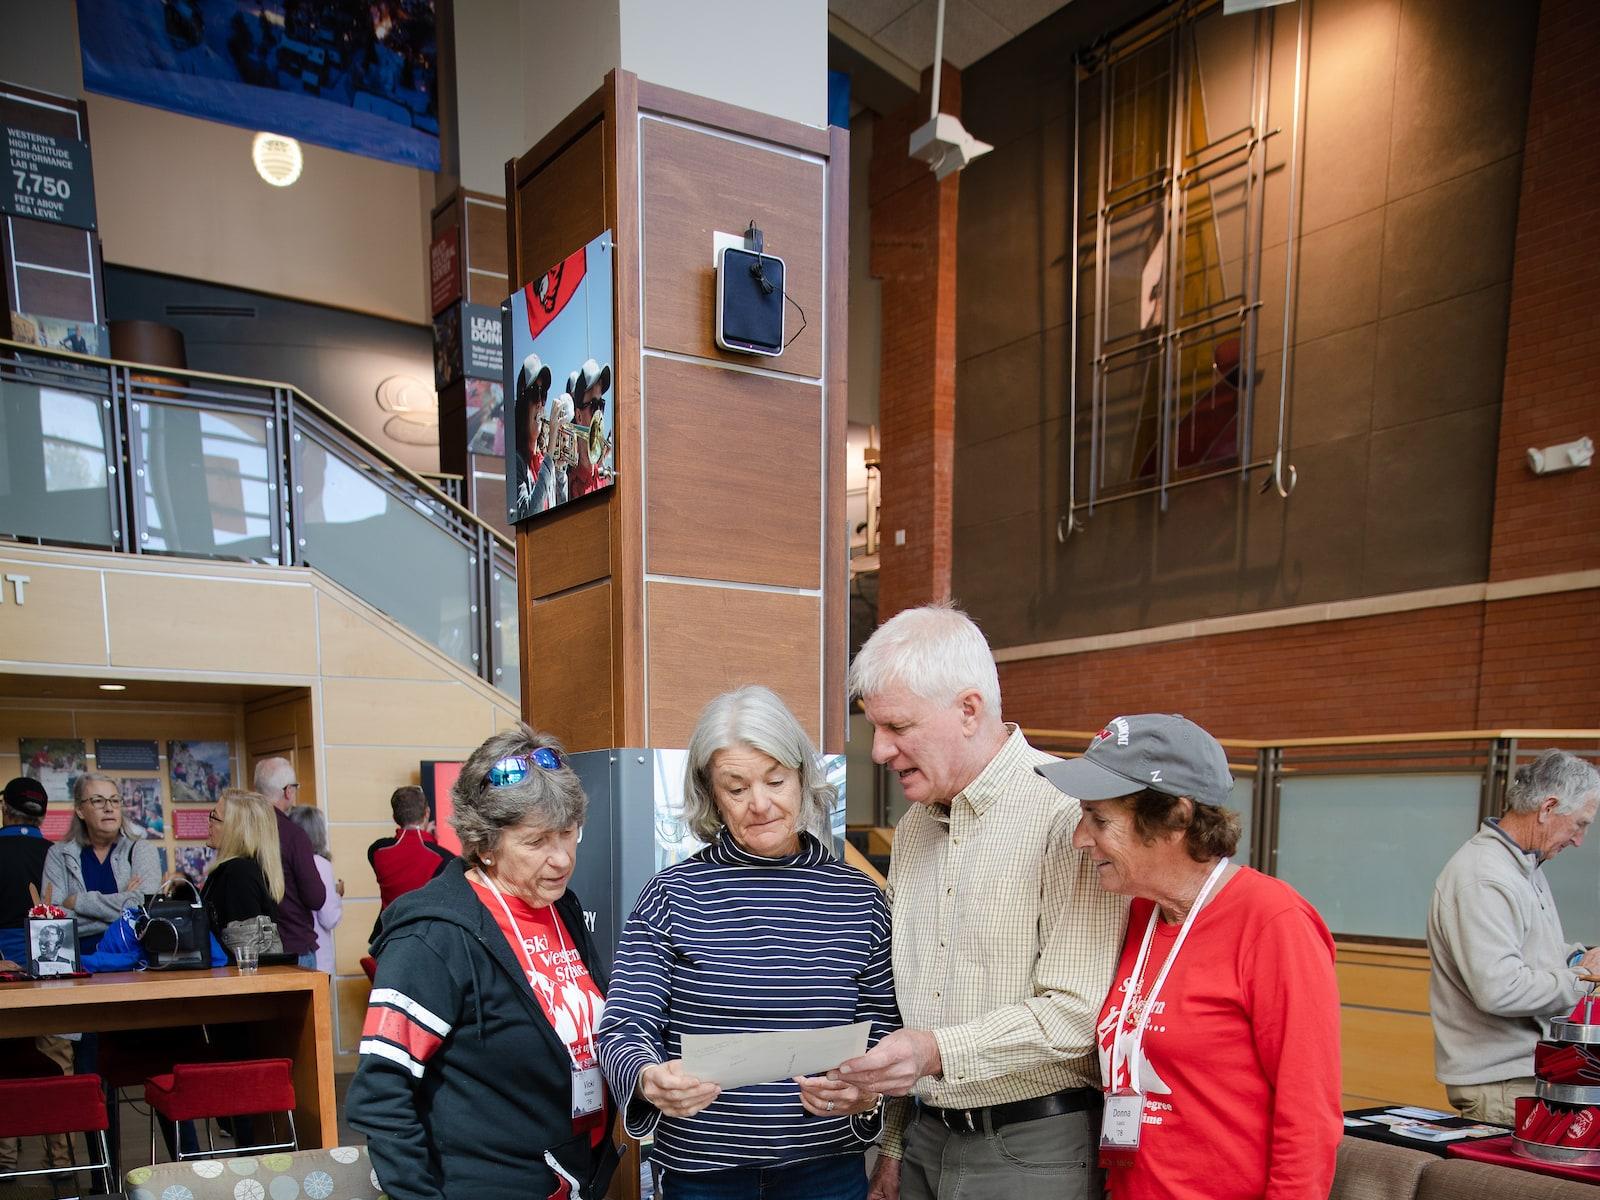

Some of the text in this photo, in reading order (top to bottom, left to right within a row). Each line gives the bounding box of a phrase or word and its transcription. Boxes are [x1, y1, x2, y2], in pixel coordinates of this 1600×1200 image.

[7, 127, 56, 146] WESTERN'S
[9, 138, 69, 159] HIGH ALTITUDE
[10, 148, 73, 170] PERFORMANCE
[10, 158, 38, 171] LAB IS
[13, 169, 71, 199] 7,750
[15, 194, 64, 212] FEET ABOVE
[15, 203, 61, 220] SEA LEVEL.
[471, 316, 503, 333] LEAR
[471, 329, 503, 345] DOIN
[0, 574, 32, 607] T
[583, 911, 597, 933] RY
[523, 933, 550, 955] Ski
[1145, 1099, 1173, 1111] egree
[1142, 1113, 1163, 1125] ime
